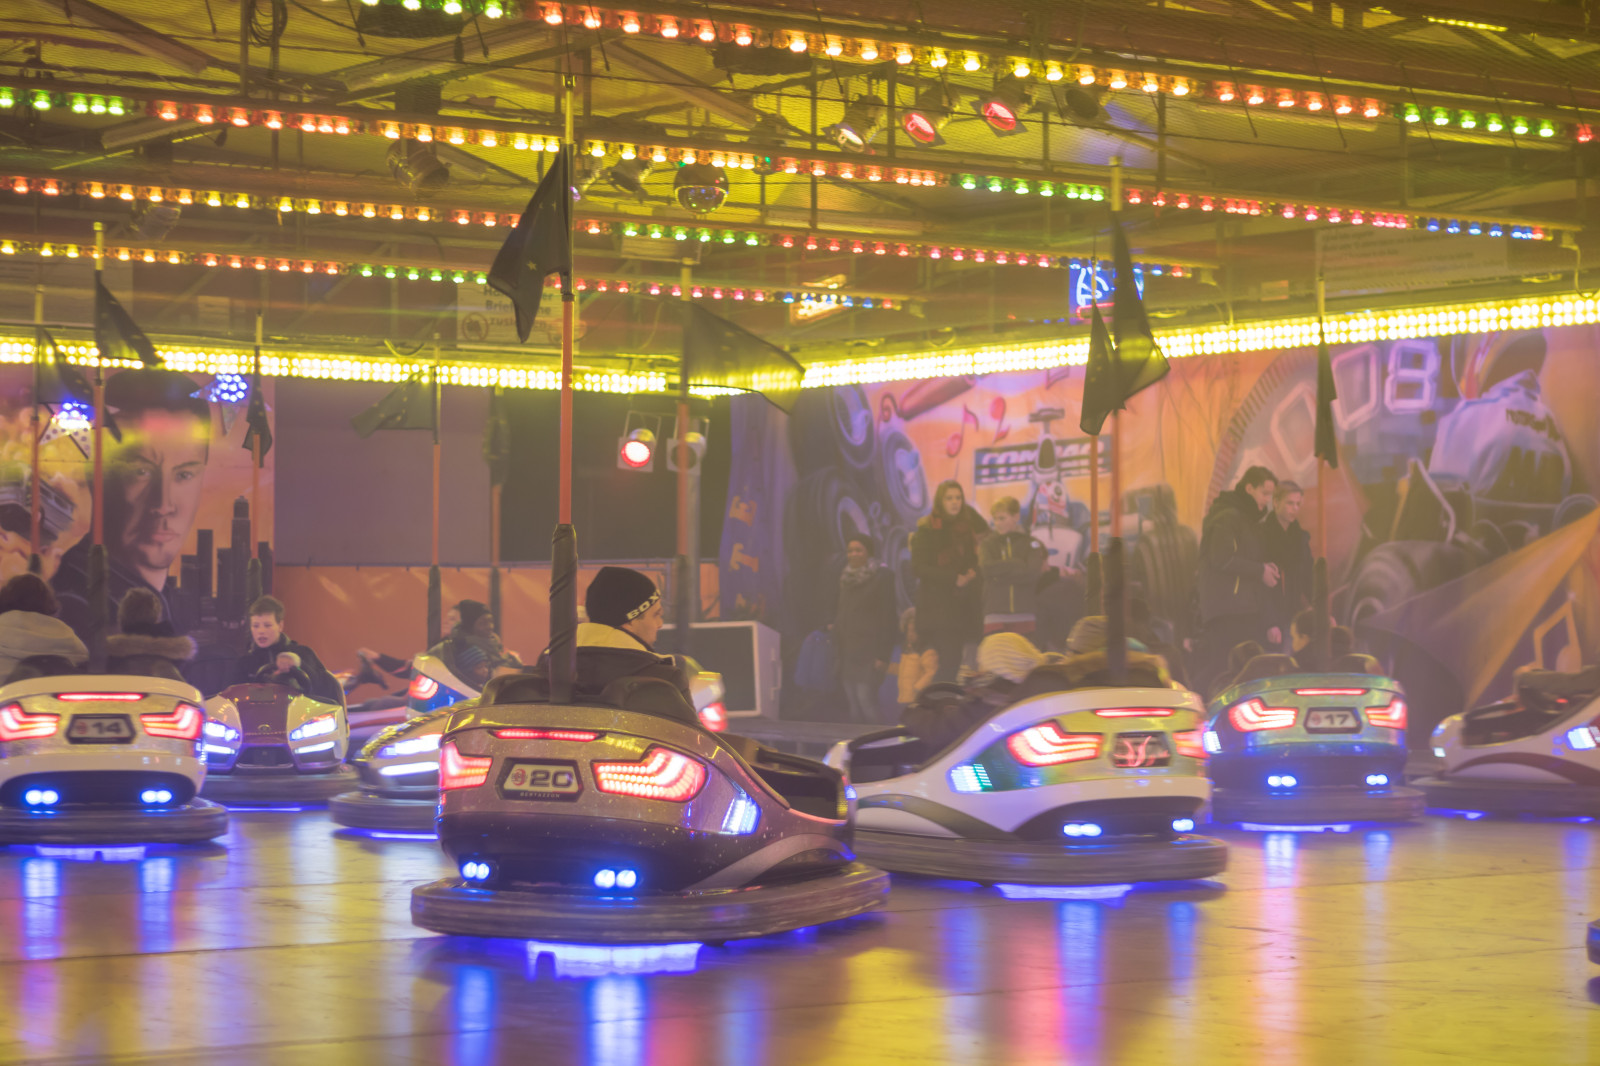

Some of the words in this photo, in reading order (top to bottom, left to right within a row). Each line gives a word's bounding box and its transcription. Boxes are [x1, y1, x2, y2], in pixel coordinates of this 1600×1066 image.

[1325, 714, 1349, 725] 17
[92, 722, 122, 734] 14
[530, 770, 573, 788] 20
